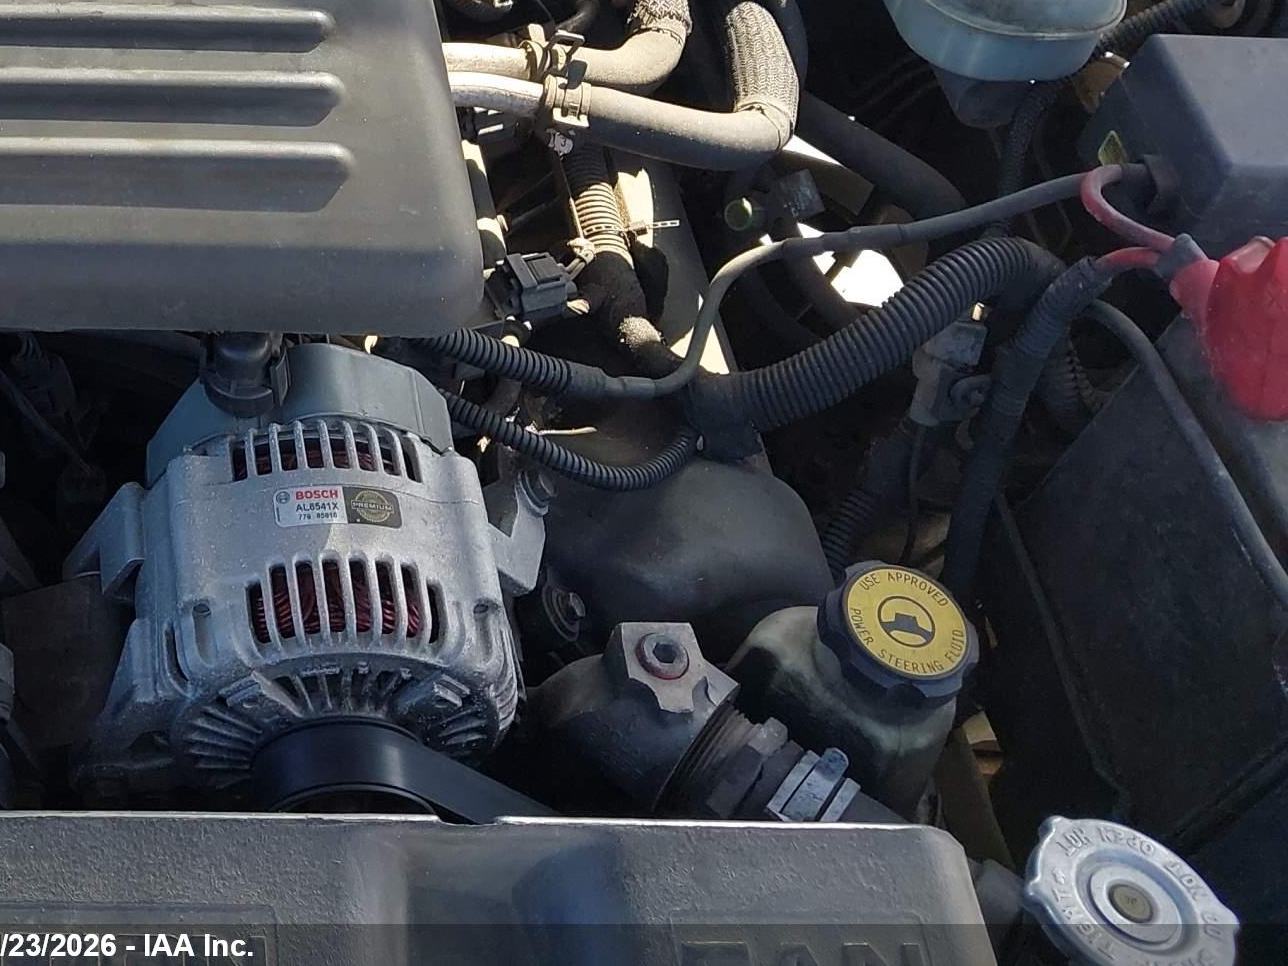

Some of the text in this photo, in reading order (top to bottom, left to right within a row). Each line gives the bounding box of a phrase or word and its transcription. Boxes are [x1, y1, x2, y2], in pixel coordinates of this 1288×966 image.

[295, 489, 339, 500] BOSCH
[351, 500, 393, 511] PREMIUM
[860, 571, 949, 607] USE APPROVED
[850, 608, 965, 674] POWER STEERING FLUID
